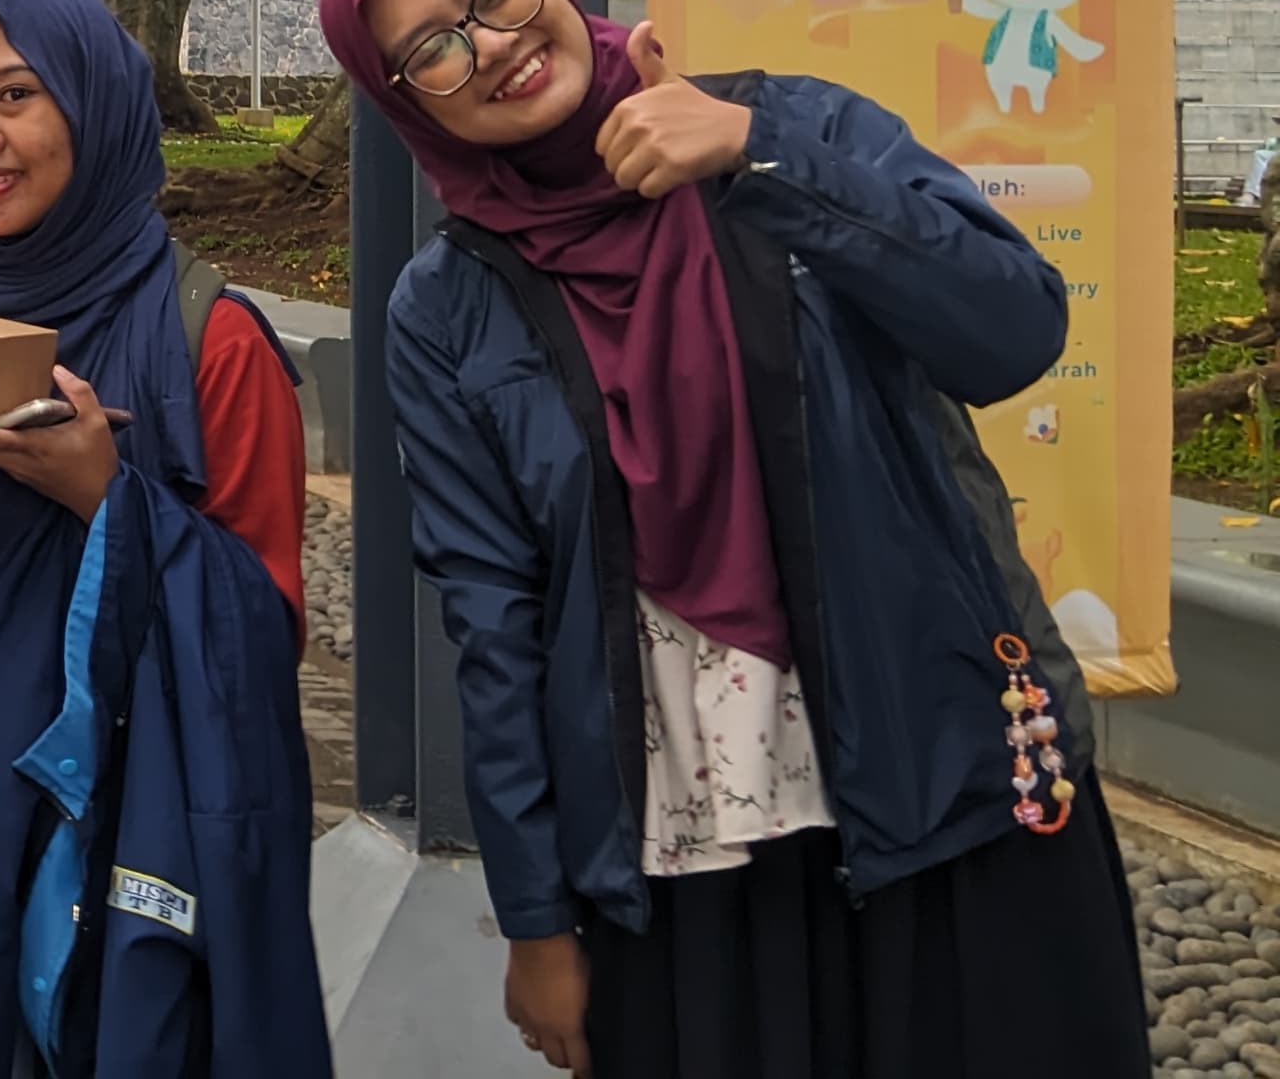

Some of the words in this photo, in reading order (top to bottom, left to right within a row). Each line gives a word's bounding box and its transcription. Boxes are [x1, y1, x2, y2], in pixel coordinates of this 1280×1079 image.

[980, 179, 1026, 196] leh:
[1037, 224, 1083, 241] Live
[1065, 282, 1099, 299] ery
[1047, 362, 1097, 378] arah
